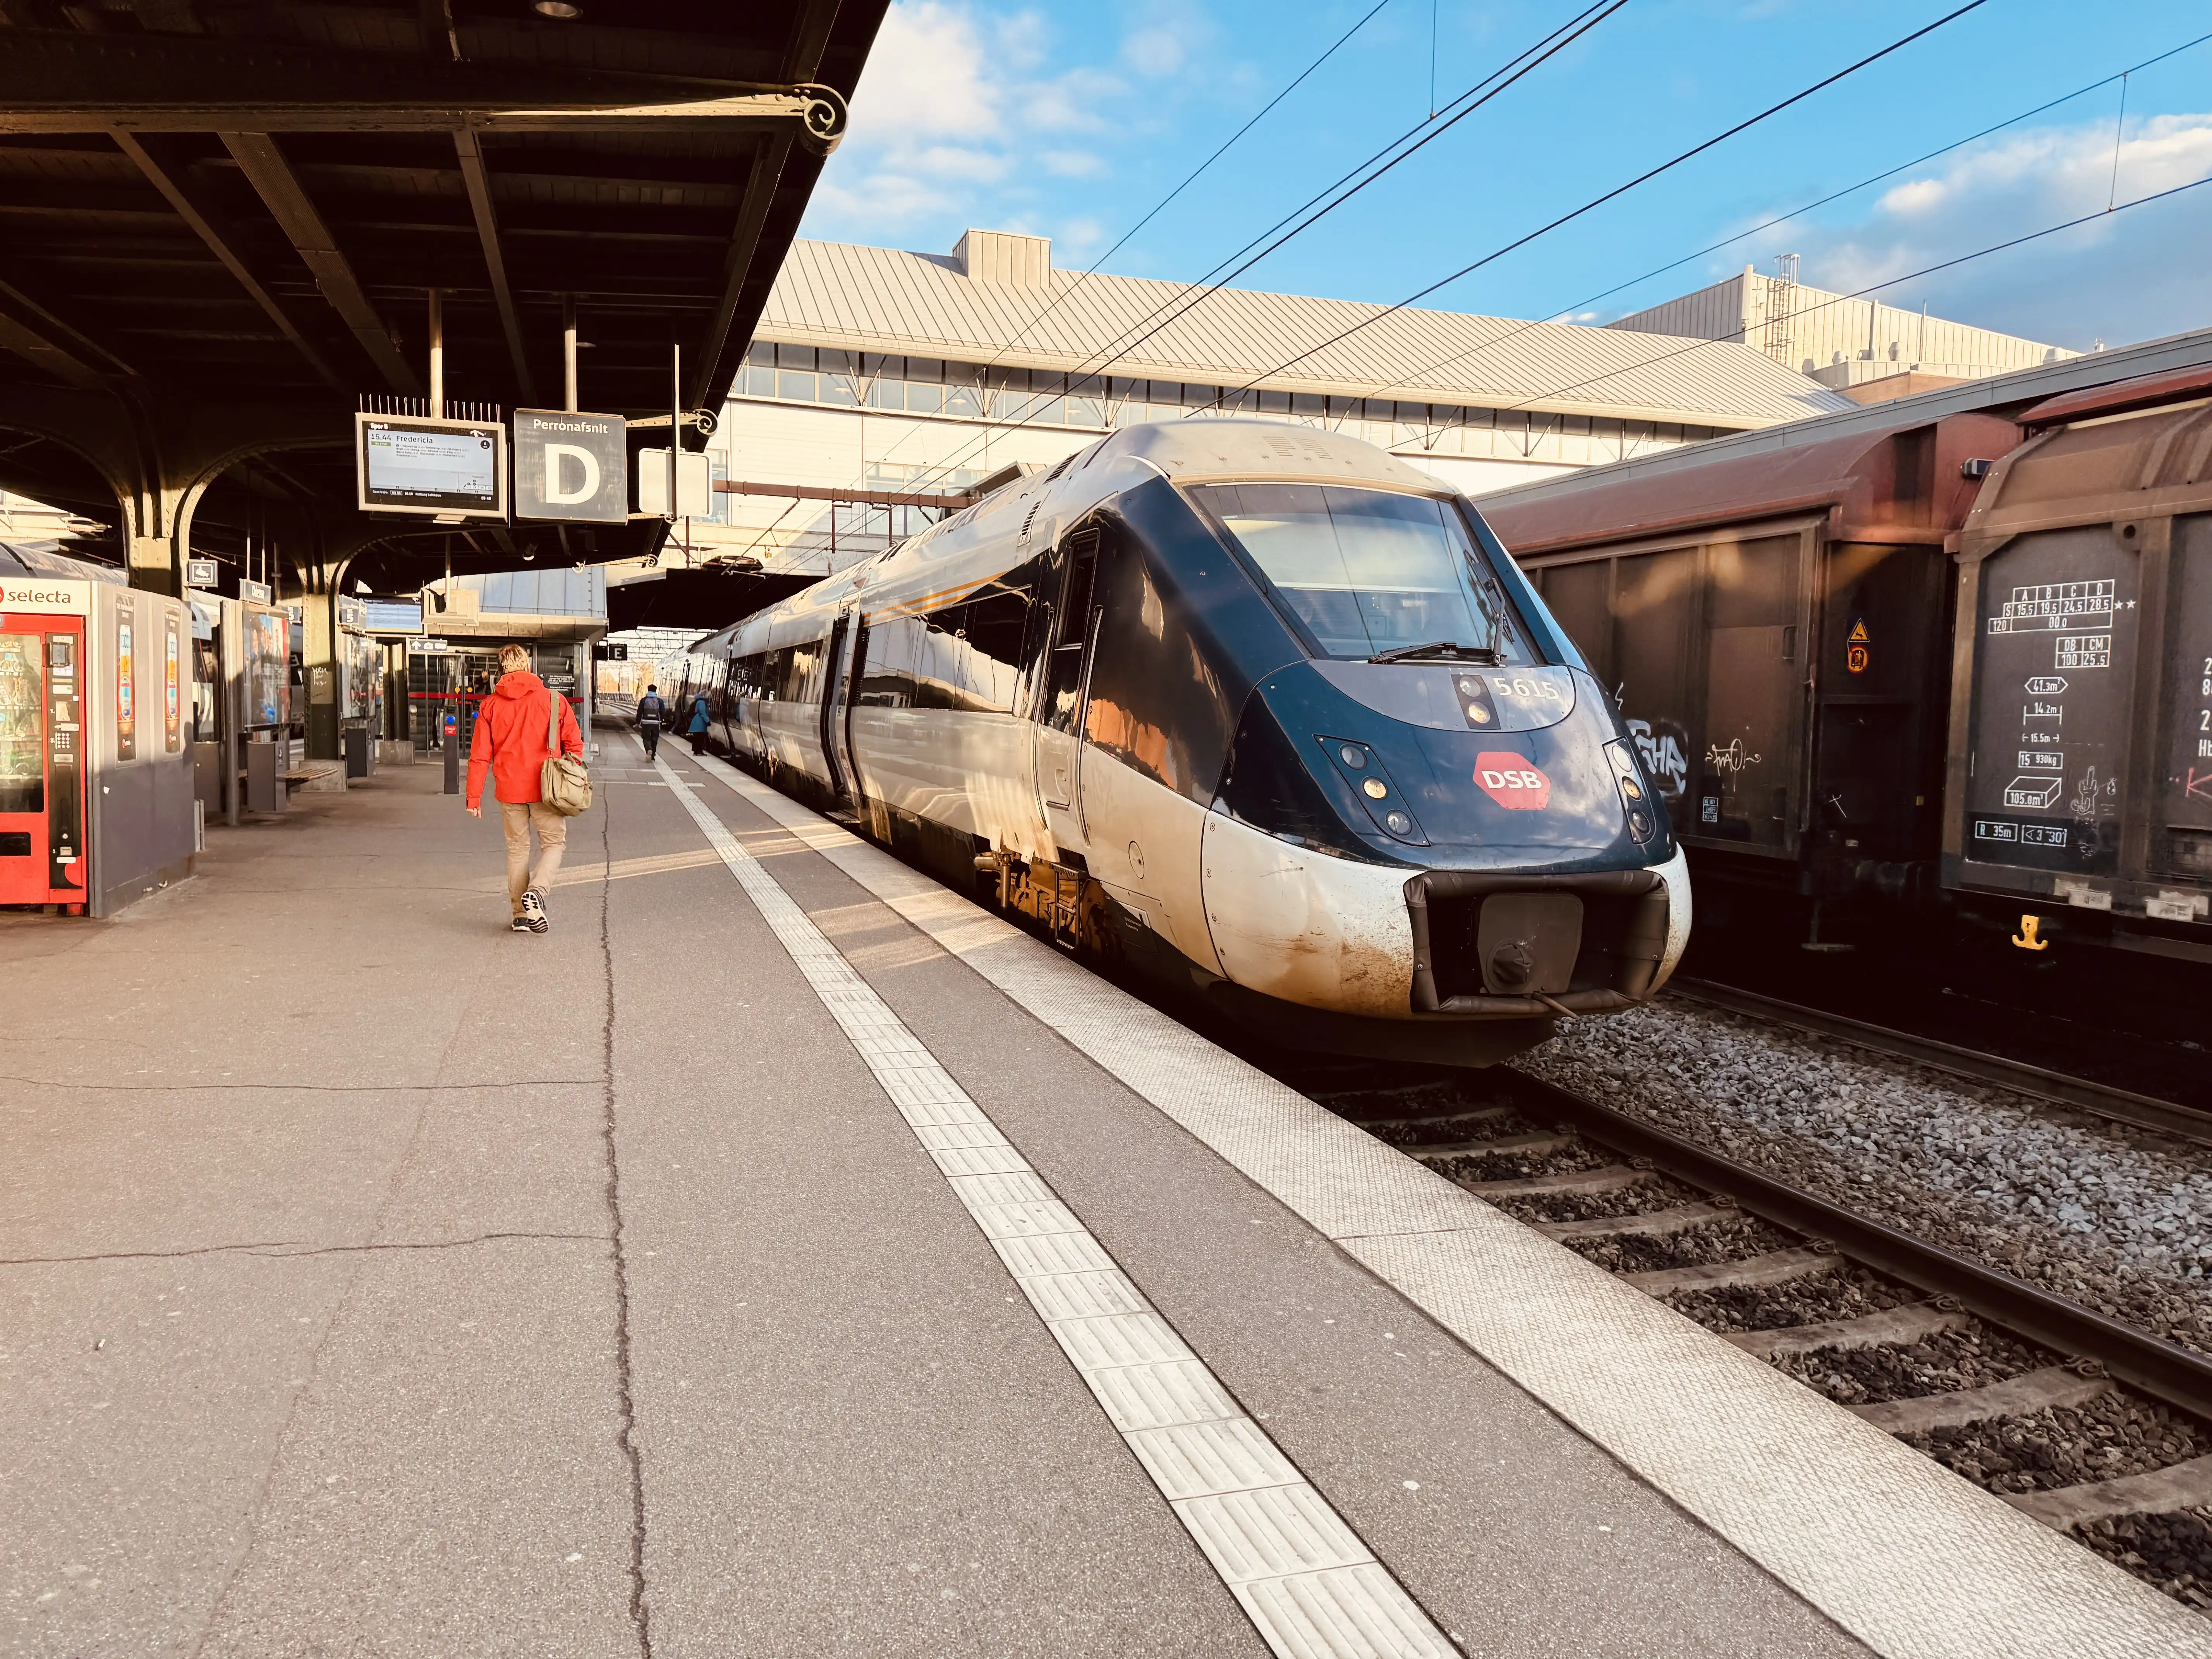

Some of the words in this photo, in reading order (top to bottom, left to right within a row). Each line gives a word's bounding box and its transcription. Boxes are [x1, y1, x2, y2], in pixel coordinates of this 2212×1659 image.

[533, 419, 608, 434] Perronafsnit
[396, 435, 433, 443] Fredericia
[545, 443, 600, 504] D
[7, 590, 71, 603] selecta
[2022, 589, 2028, 601] A
[2046, 587, 2052, 599] B
[2071, 585, 2076, 597] C
[2097, 583, 2103, 595] D
[2005, 605, 2011, 617] S
[2017, 604, 2033, 616] 15.5
[2041, 602, 2057, 614] 19.5
[2063, 600, 2083, 613] 24.5
[2090, 599, 2109, 611] 28.5
[1993, 620, 2007, 632] 120
[2089, 638, 2103, 651] CM
[614, 648, 622, 659] E
[2061, 653, 2077, 666] 100
[2084, 653, 2105, 665] 25.5
[1492, 677, 1560, 700] 5615
[2031, 733, 2051, 743] 15.5m
[2021, 754, 2030, 766] 15
[2036, 754, 2057, 766] 930kg
[1481, 770, 1542, 789] DSB
[1980, 824, 1985, 836] R
[1993, 826, 2012, 838] 35m
